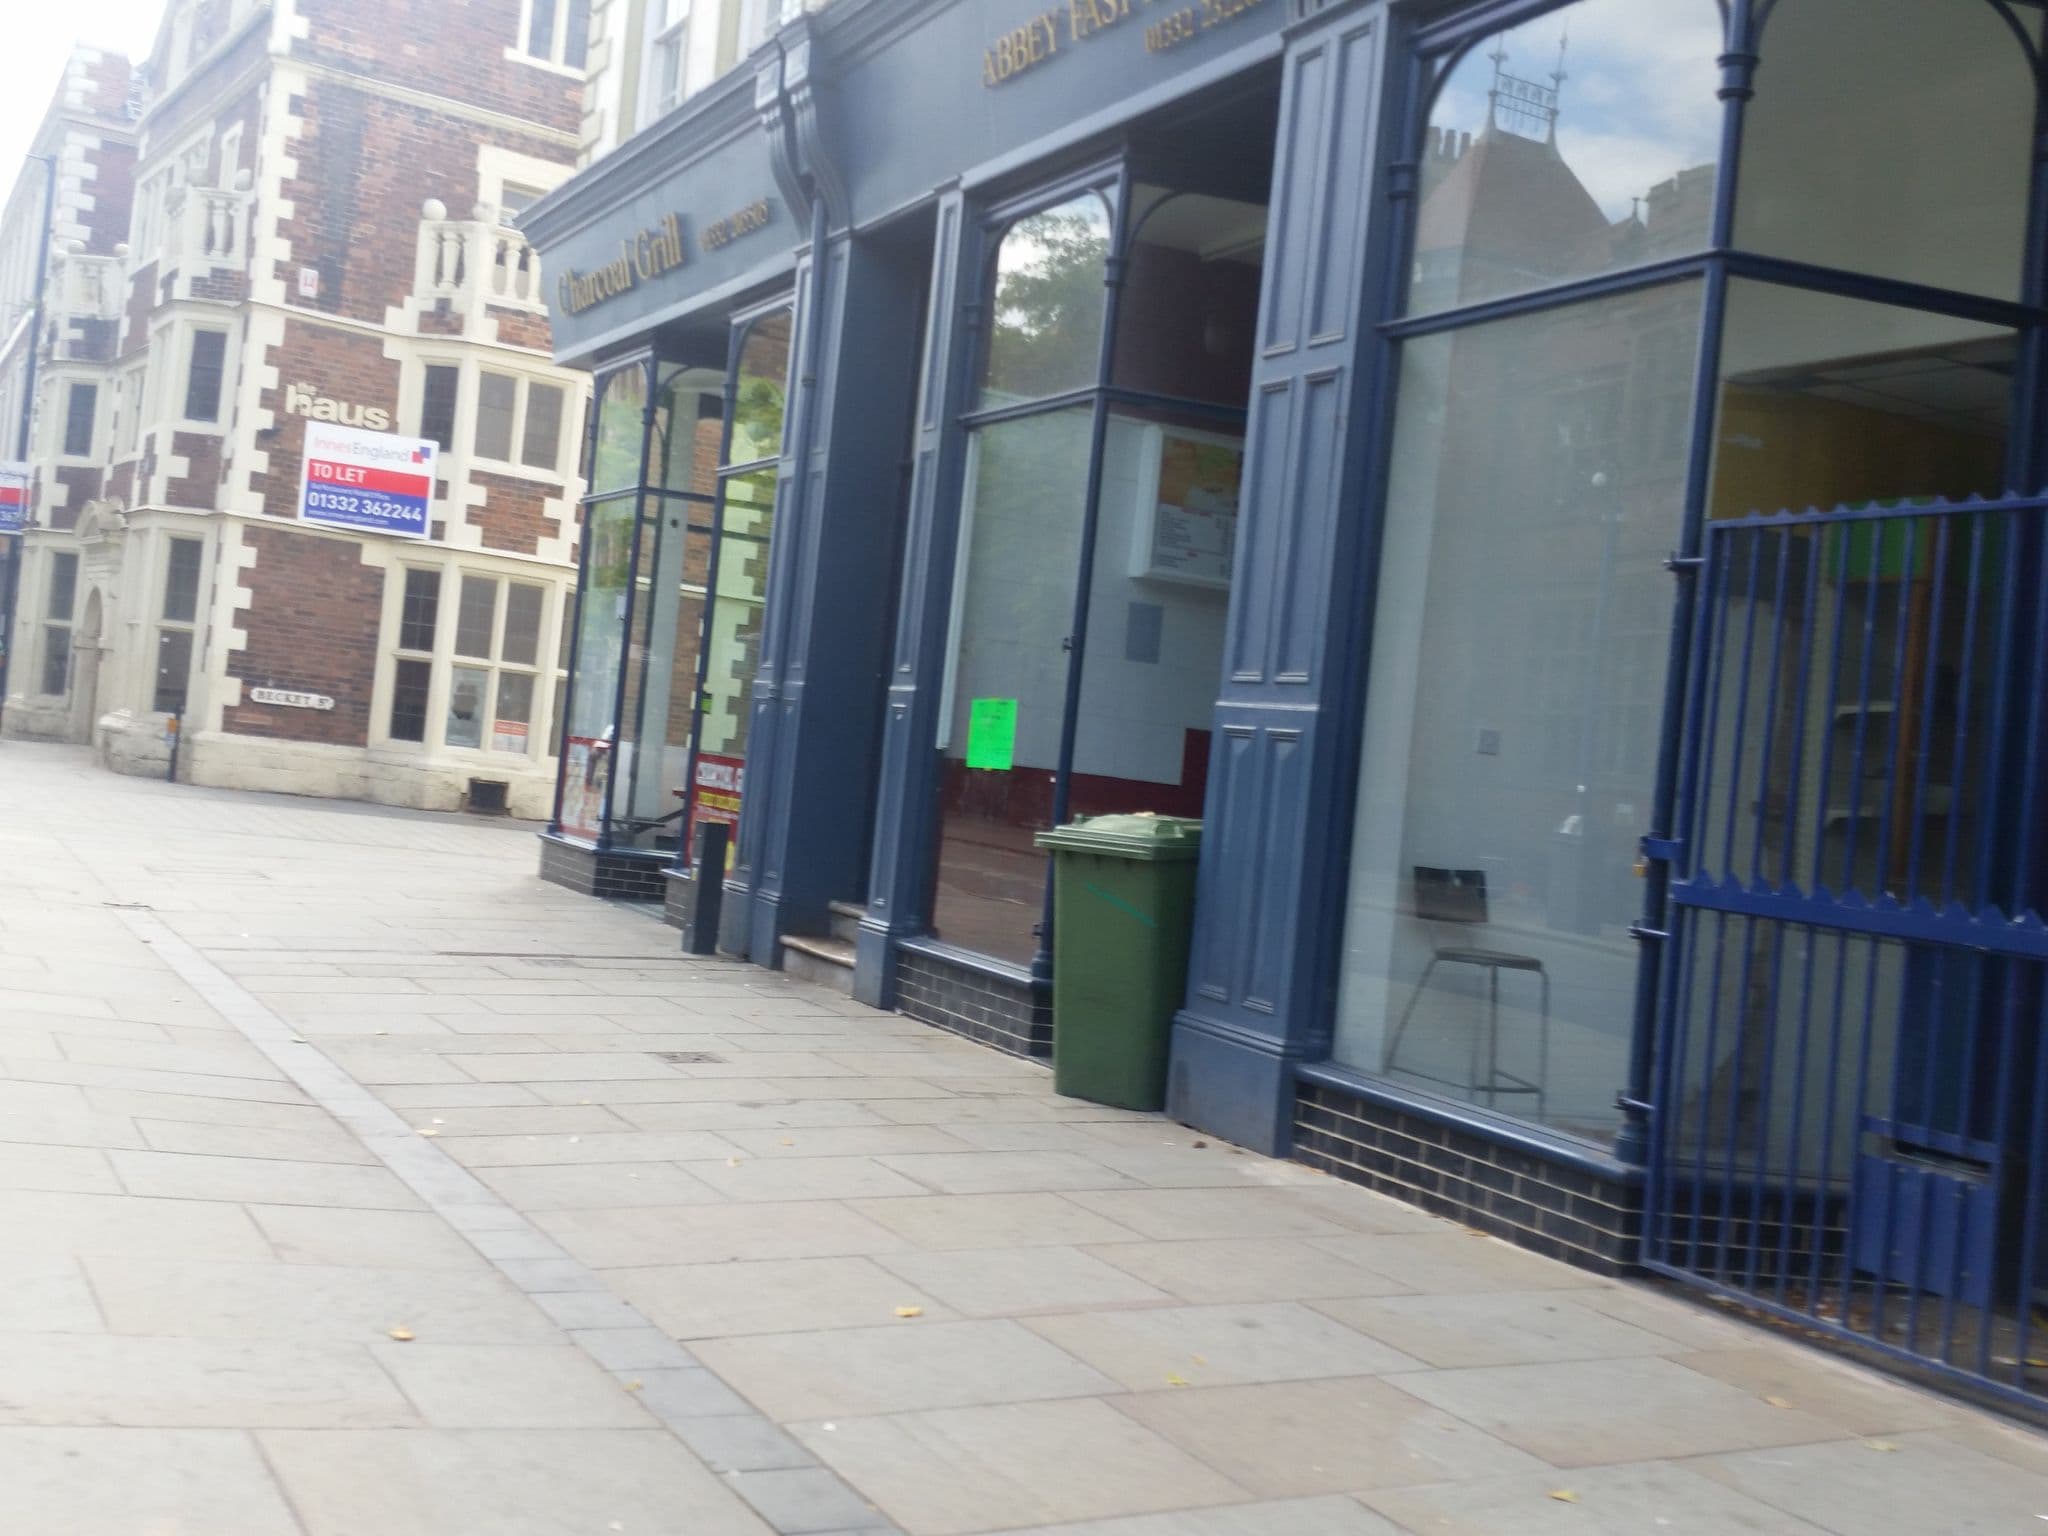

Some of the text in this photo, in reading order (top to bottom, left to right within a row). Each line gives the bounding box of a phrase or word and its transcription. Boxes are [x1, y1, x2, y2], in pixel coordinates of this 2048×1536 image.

[983, 9, 1058, 88] ABBEY
[558, 240, 632, 318] Charcoal
[634, 211, 684, 280] Grill
[285, 384, 390, 430] haus
[311, 463, 367, 483] TO LET
[307, 491, 359, 512] 01332
[361, 499, 423, 522] 362244
